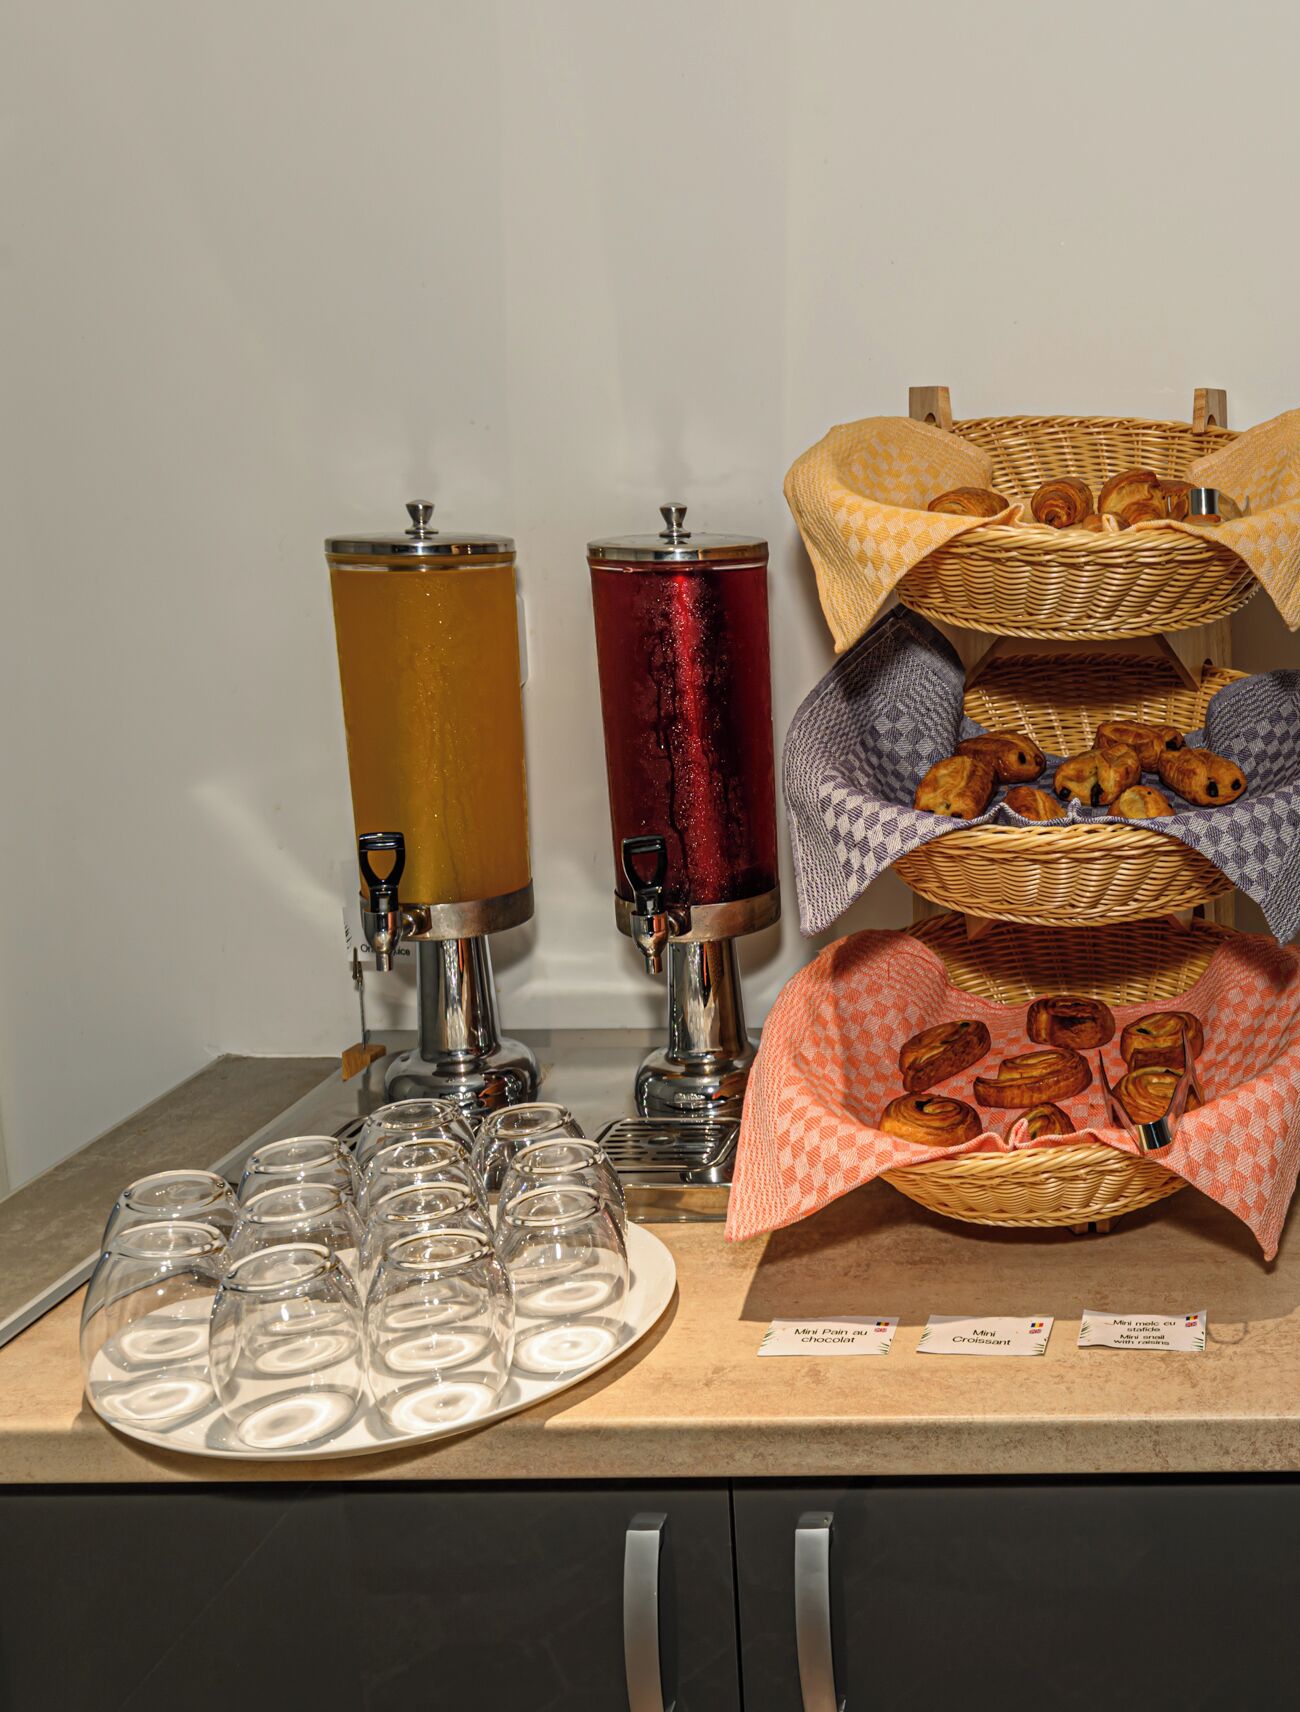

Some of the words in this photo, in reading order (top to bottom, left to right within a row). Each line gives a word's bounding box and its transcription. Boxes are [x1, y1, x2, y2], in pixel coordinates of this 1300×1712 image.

[1113, 1319, 1132, 1327] Mini
[822, 1328, 848, 1336] Pain
[972, 1329, 996, 1338] Mini
[952, 1335, 1011, 1346] Croissant
